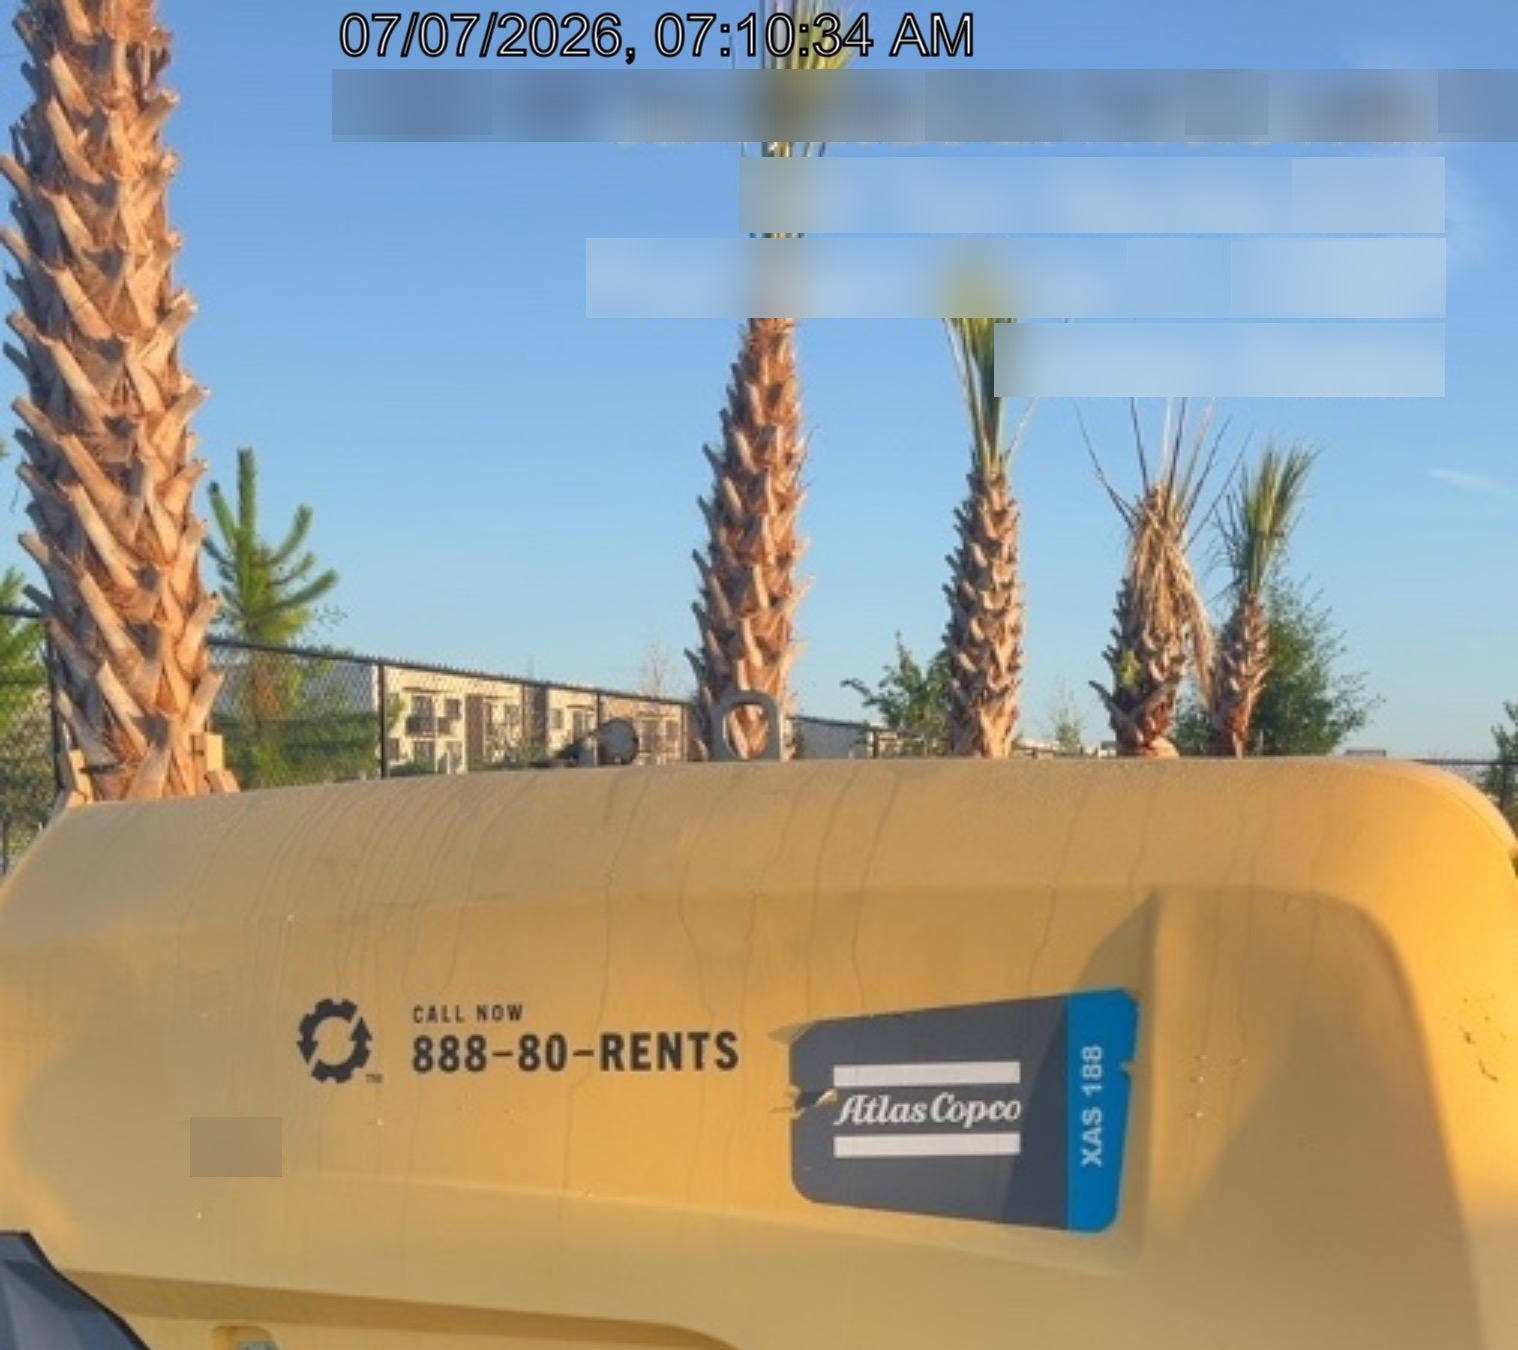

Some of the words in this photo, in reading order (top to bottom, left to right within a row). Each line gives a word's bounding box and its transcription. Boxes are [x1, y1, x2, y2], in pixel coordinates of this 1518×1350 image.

[413, 1004, 465, 1024] CALL
[476, 1003, 524, 1022] NOW
[412, 1030, 739, 1074] 888-80-RENTS
[1081, 1045, 1103, 1097] 188
[1081, 1106, 1103, 1168] XAS
